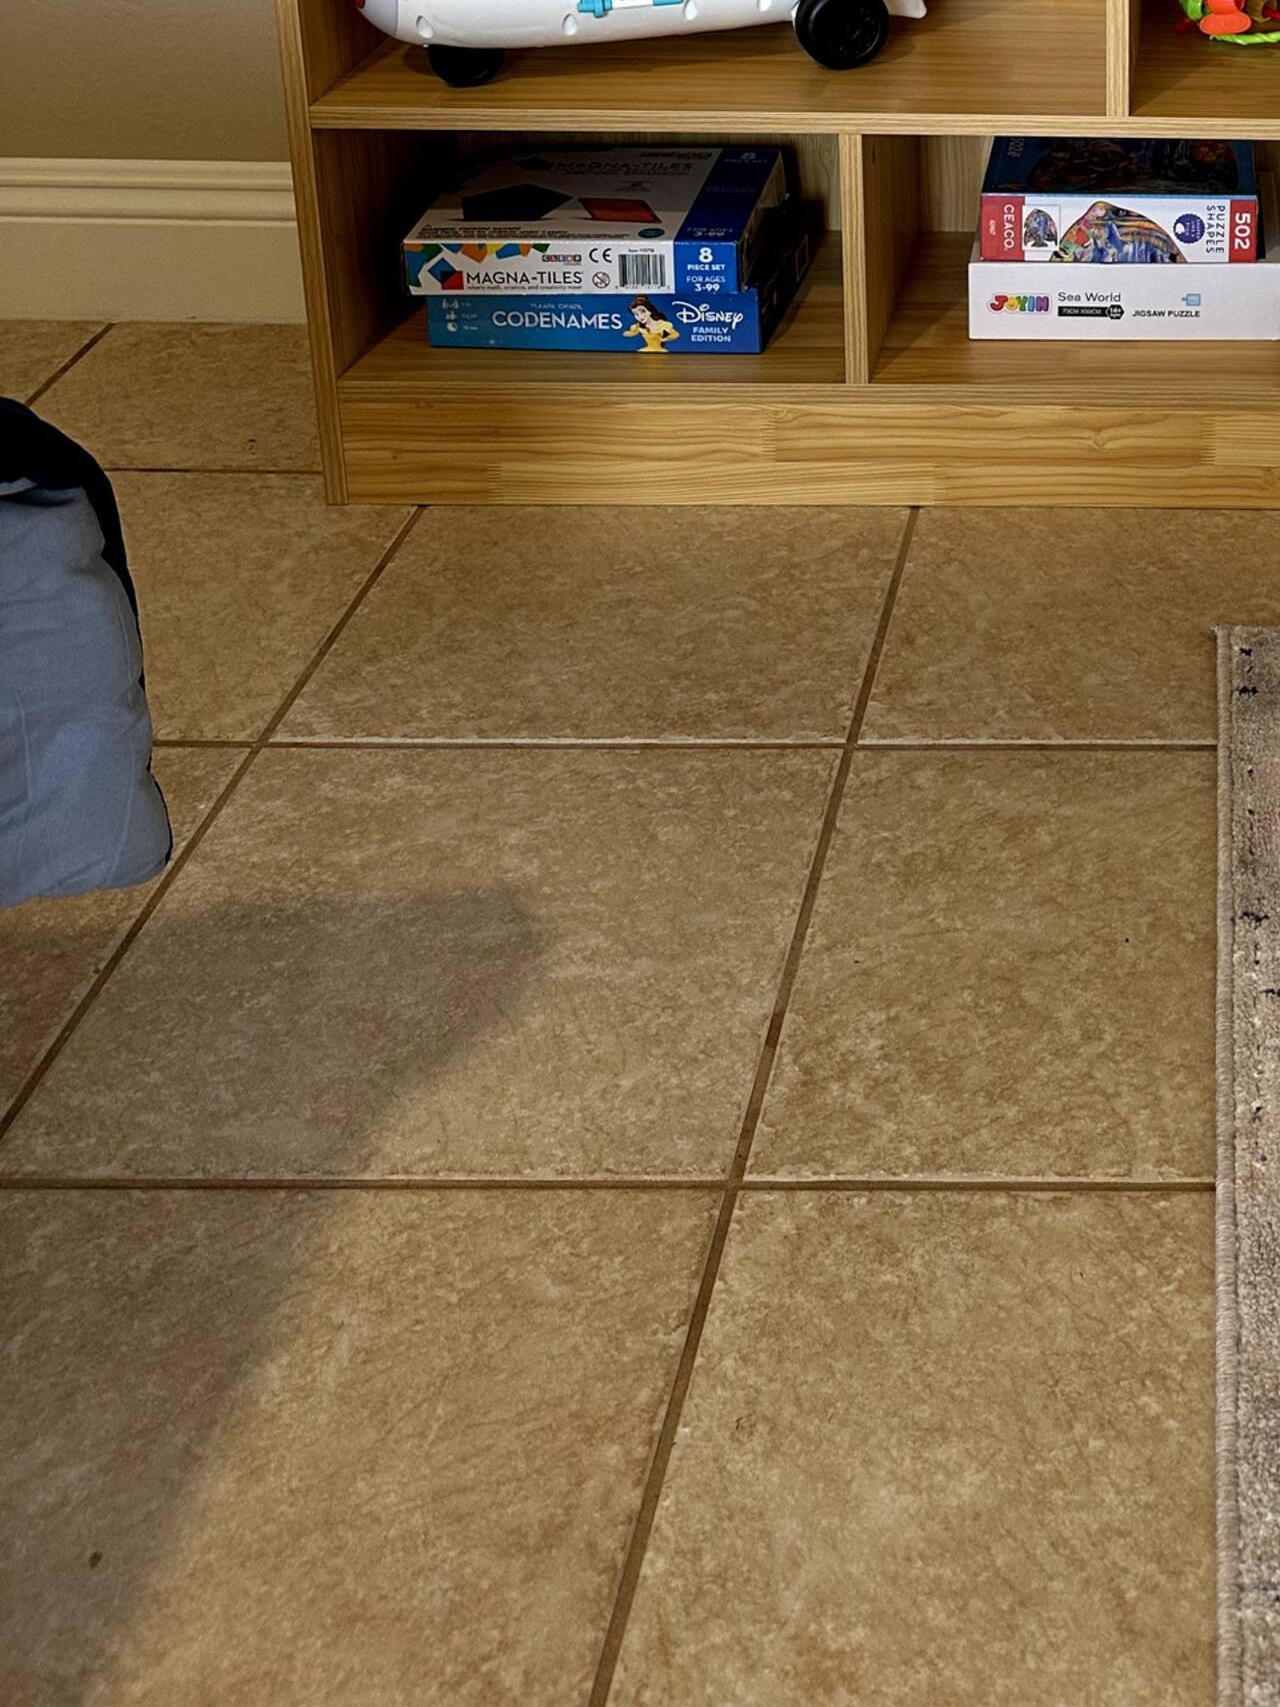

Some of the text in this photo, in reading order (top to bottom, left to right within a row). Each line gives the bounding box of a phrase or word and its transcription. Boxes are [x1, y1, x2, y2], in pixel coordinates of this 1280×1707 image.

[1002, 204, 1016, 248] CEACO
[1205, 205, 1216, 254] SHAPES
[1215, 205, 1226, 255] PUZZLE
[1234, 212, 1251, 250] 502
[699, 247, 713, 263] 8
[466, 271, 583, 284] MAGNA-TILES
[686, 275, 726, 283] FOR AGES
[694, 283, 720, 292] 3-99
[990, 295, 1050, 312] JOYIN
[1058, 292, 1121, 303] Sea World
[492, 311, 623, 330] CODENAMES
[1132, 310, 1201, 318] JIGSAW PUZZLE
[692, 326, 729, 335] FAMILY
[691, 334, 731, 343] EDITION
